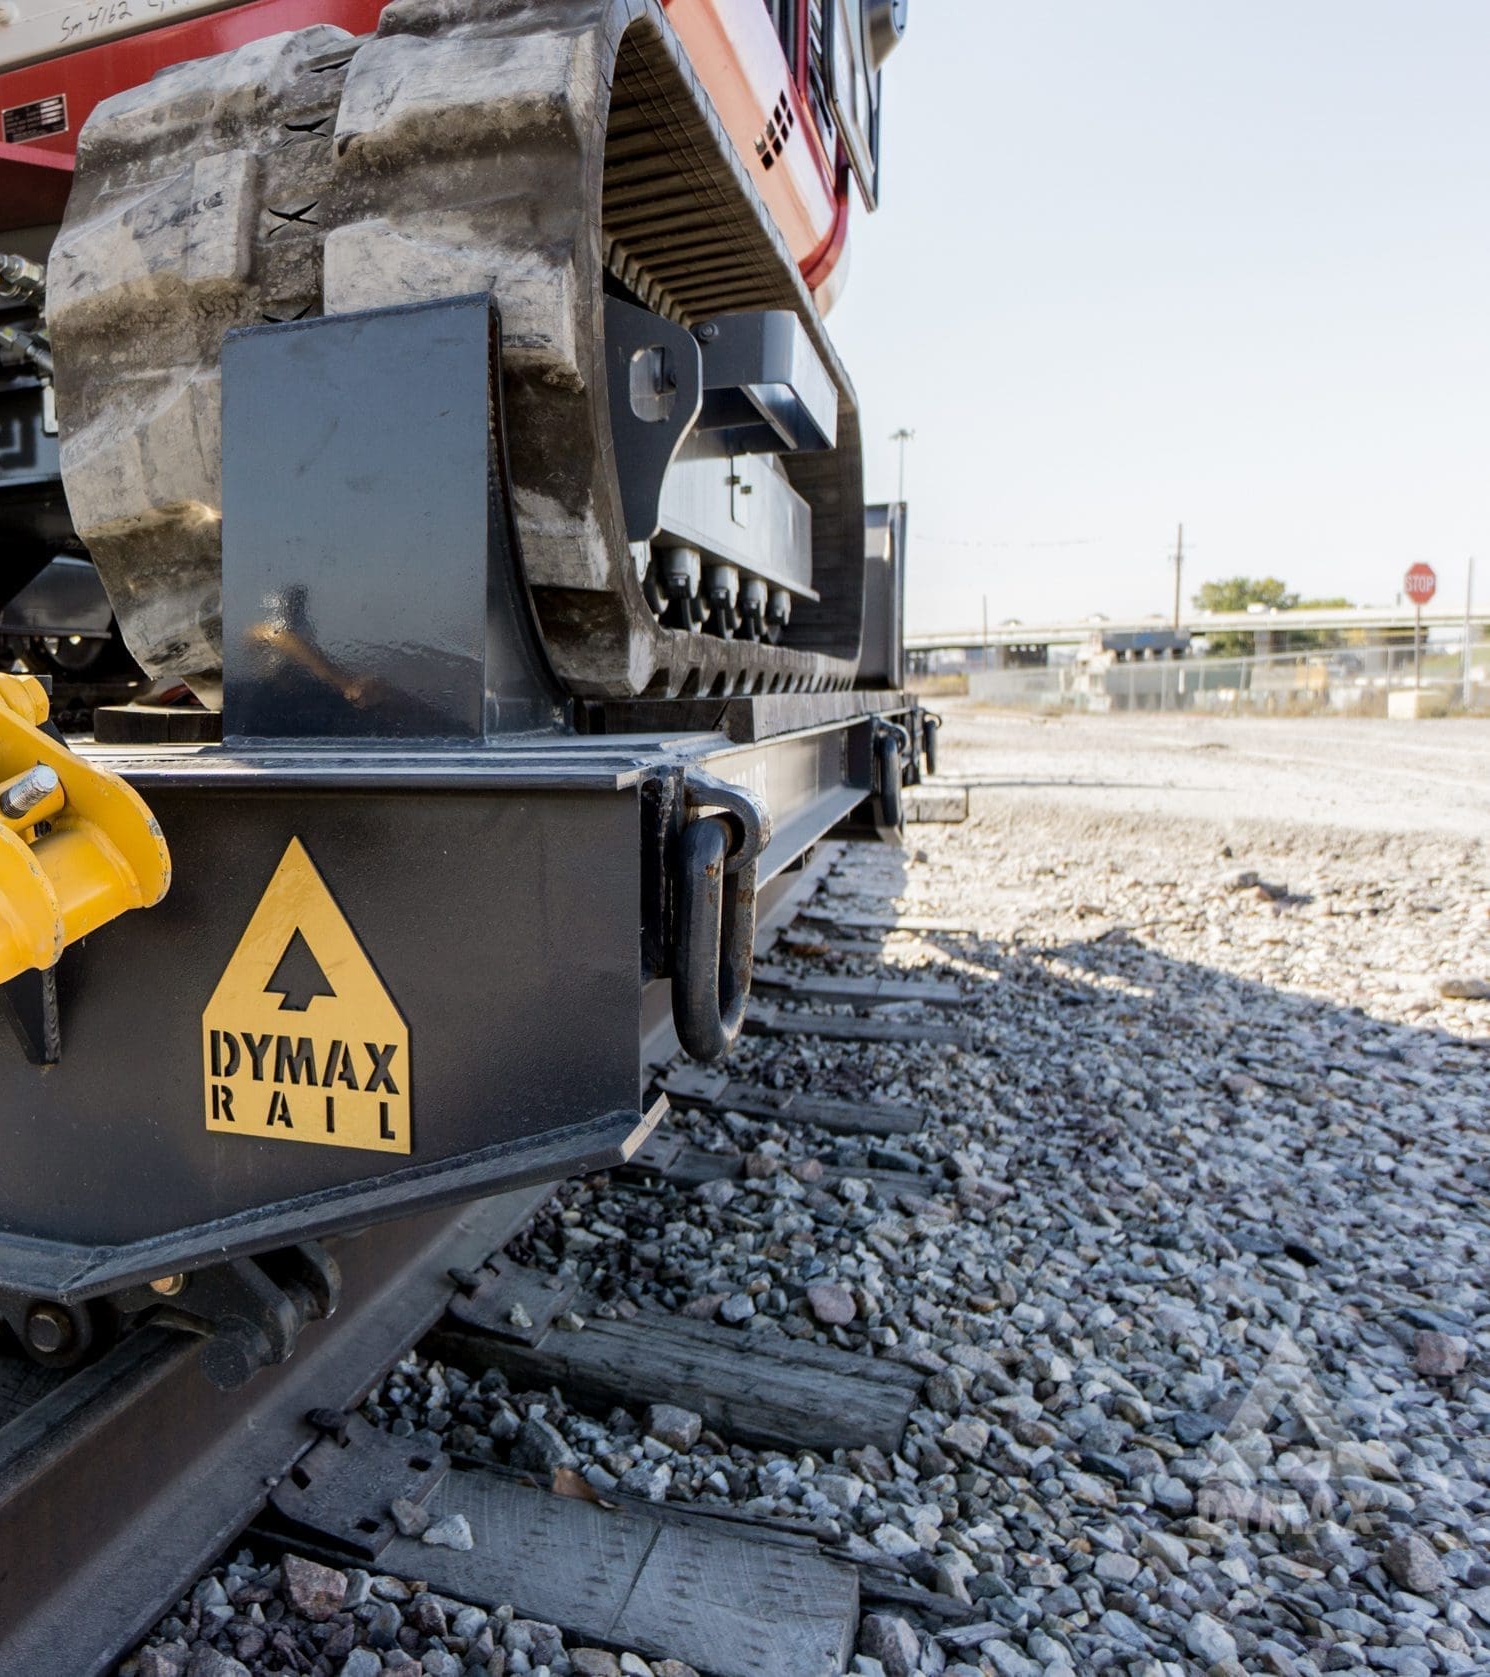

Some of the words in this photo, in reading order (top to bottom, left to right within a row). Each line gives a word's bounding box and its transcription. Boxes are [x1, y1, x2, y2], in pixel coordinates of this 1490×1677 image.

[1404, 575, 1436, 592] STOP
[210, 1029, 400, 1095] DYMAX
[212, 1084, 395, 1140] RAIL
